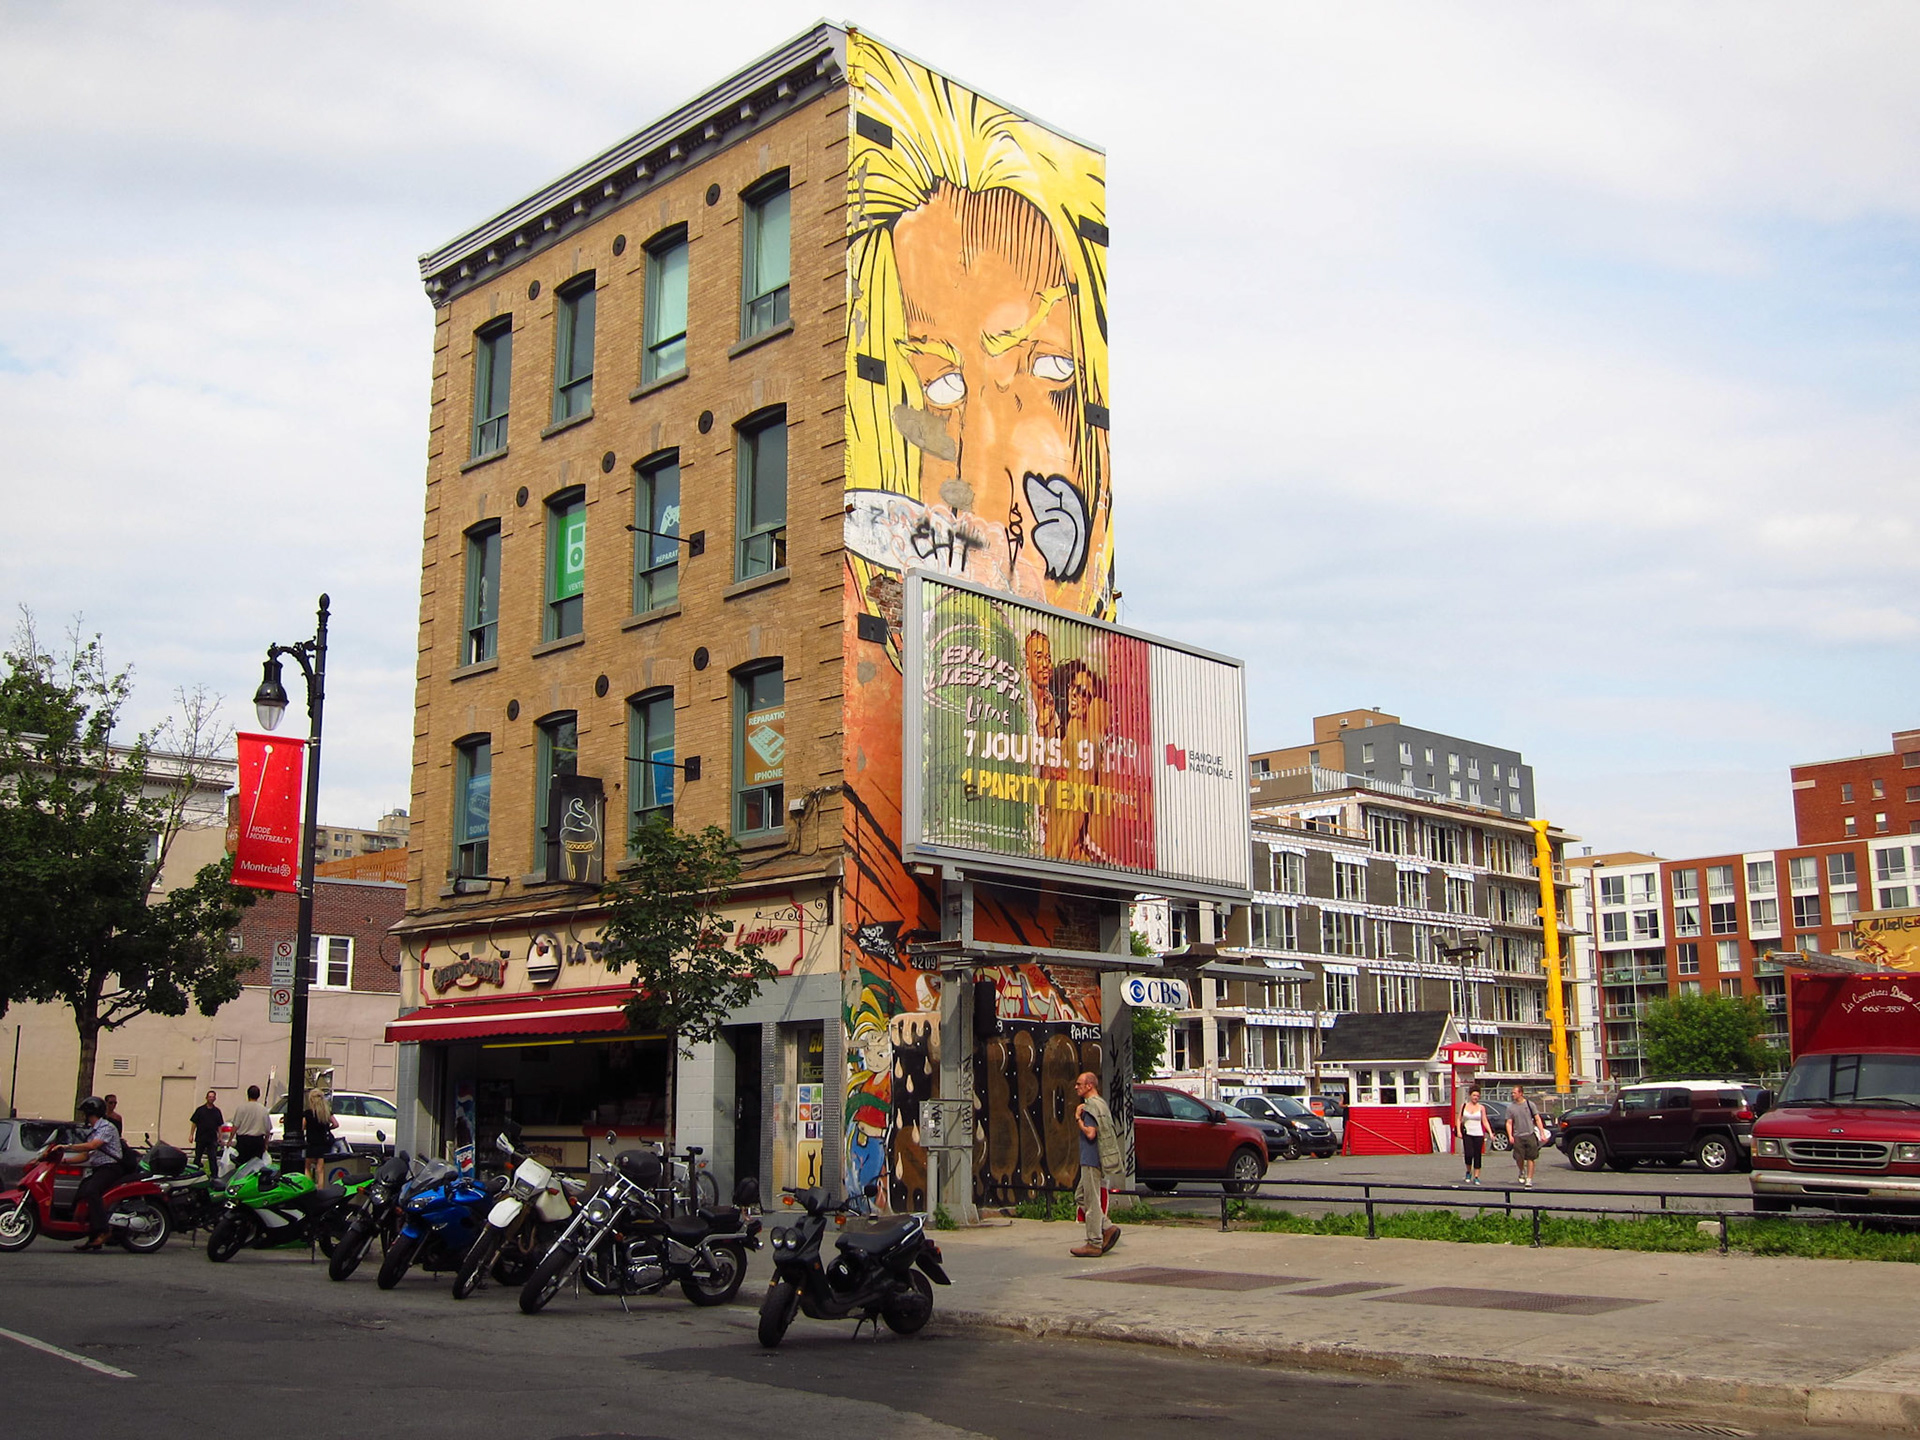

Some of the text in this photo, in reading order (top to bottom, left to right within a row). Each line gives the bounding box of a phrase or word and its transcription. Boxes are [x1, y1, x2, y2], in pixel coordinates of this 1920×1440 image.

[963, 729, 977, 757] 7
[1188, 750, 1224, 766] BANQUE
[754, 767, 784, 782] IPHONE
[1188, 762, 1234, 780] NATIONALE
[977, 769, 1050, 806] PARTY
[251, 825, 272, 835] MODE
[240, 860, 280, 875] Montréal
[911, 955, 938, 970] 4209
[1147, 980, 1181, 1005] CBS
[1070, 1024, 1102, 1040] PARIS
